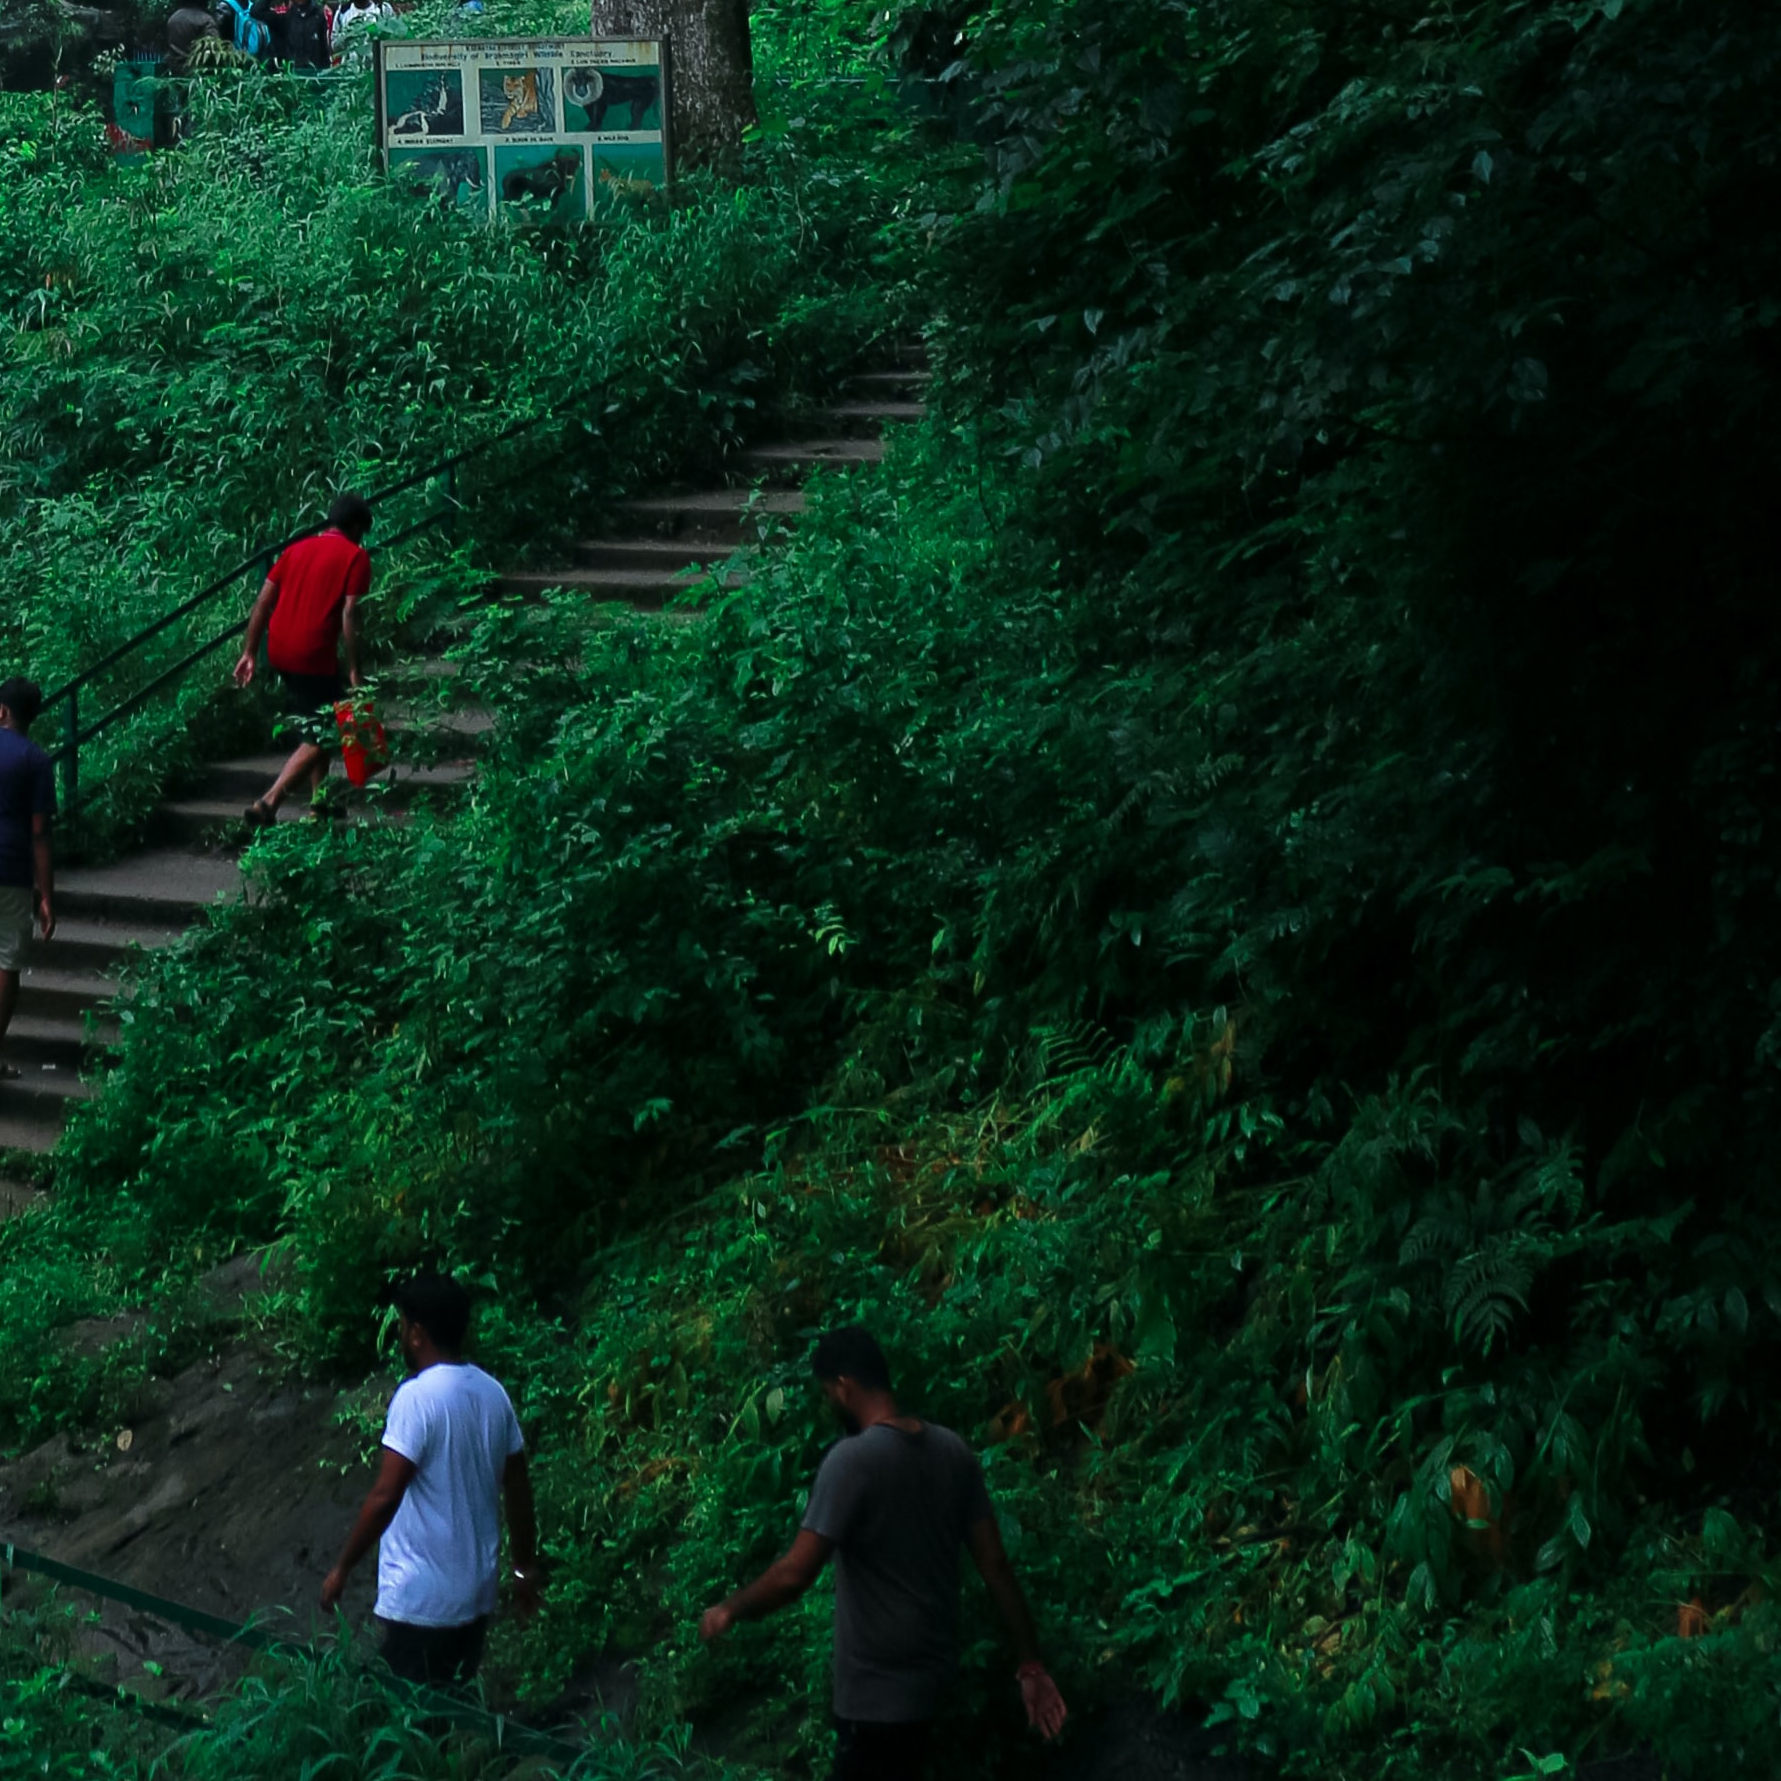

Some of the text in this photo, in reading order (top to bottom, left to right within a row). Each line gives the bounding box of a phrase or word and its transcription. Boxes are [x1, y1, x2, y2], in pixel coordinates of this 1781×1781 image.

[421, 52, 467, 62] Biodiversity
[470, 52, 479, 60] of
[570, 50, 612, 59] Sanctuary
